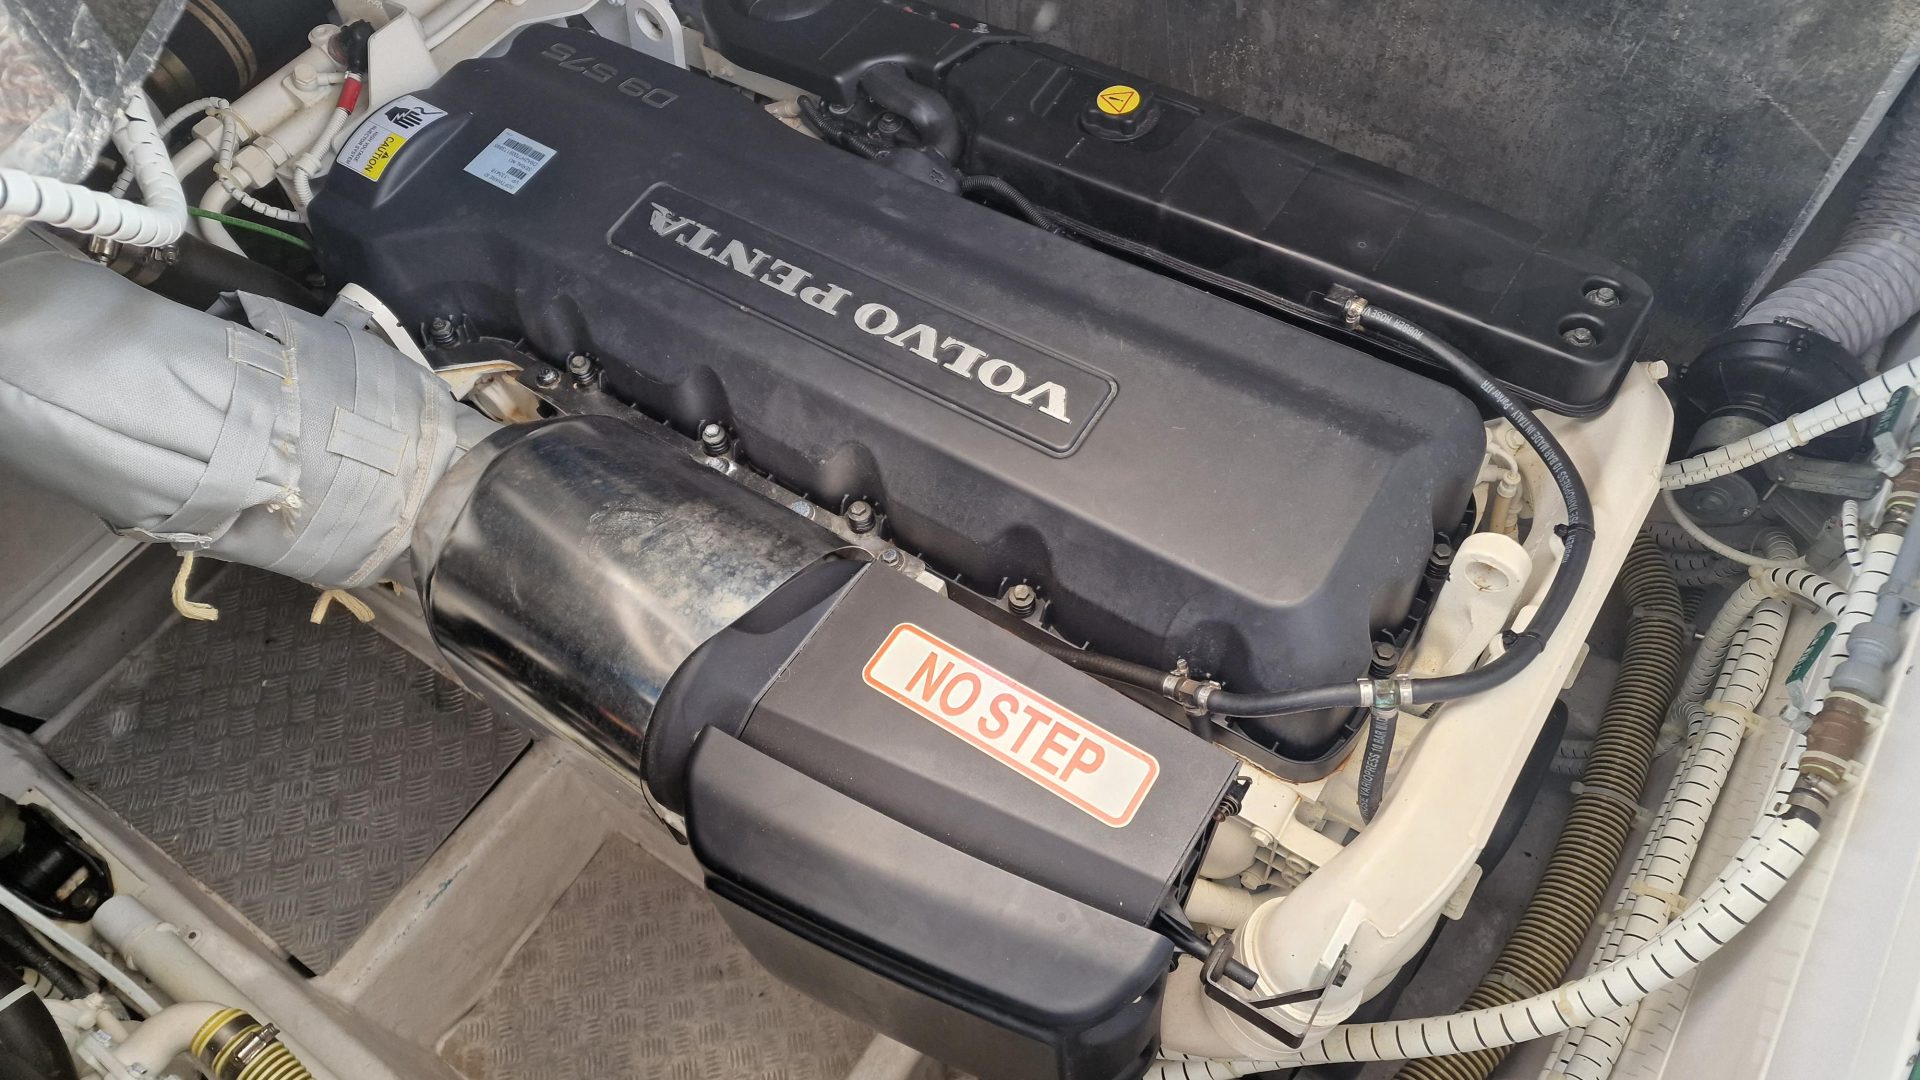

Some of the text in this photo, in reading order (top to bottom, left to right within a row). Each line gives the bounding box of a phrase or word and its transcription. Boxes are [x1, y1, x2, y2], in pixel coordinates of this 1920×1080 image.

[540, 42, 680, 110] D9 575
[346, 125, 377, 164] INJECTOR SYSTEM
[355, 131, 379, 161] HIGH VOLTAGE
[364, 136, 395, 172] CAUTION
[515, 161, 532, 171] SERIAL
[489, 175, 515, 189] SOFTWARE
[649, 201, 1071, 425] VOLVO PENTA
[1370, 308, 1424, 340] RUBBER HOSE
[1479, 379, 1495, 393] ITR
[1491, 388, 1512, 409] Parker
[1510, 408, 1530, 428] ITALY
[1524, 423, 1537, 434] IN
[1529, 430, 1550, 451] MADE
[1543, 448, 1559, 465] BAR
[1551, 463, 1563, 472] 10
[1557, 470, 1578, 513] VARIOPRESS
[904, 650, 1107, 784] NO STEP
[1372, 729, 1386, 744] BAR
[1370, 743, 1383, 752] 10
[1359, 751, 1380, 796] VARIOPRESS
